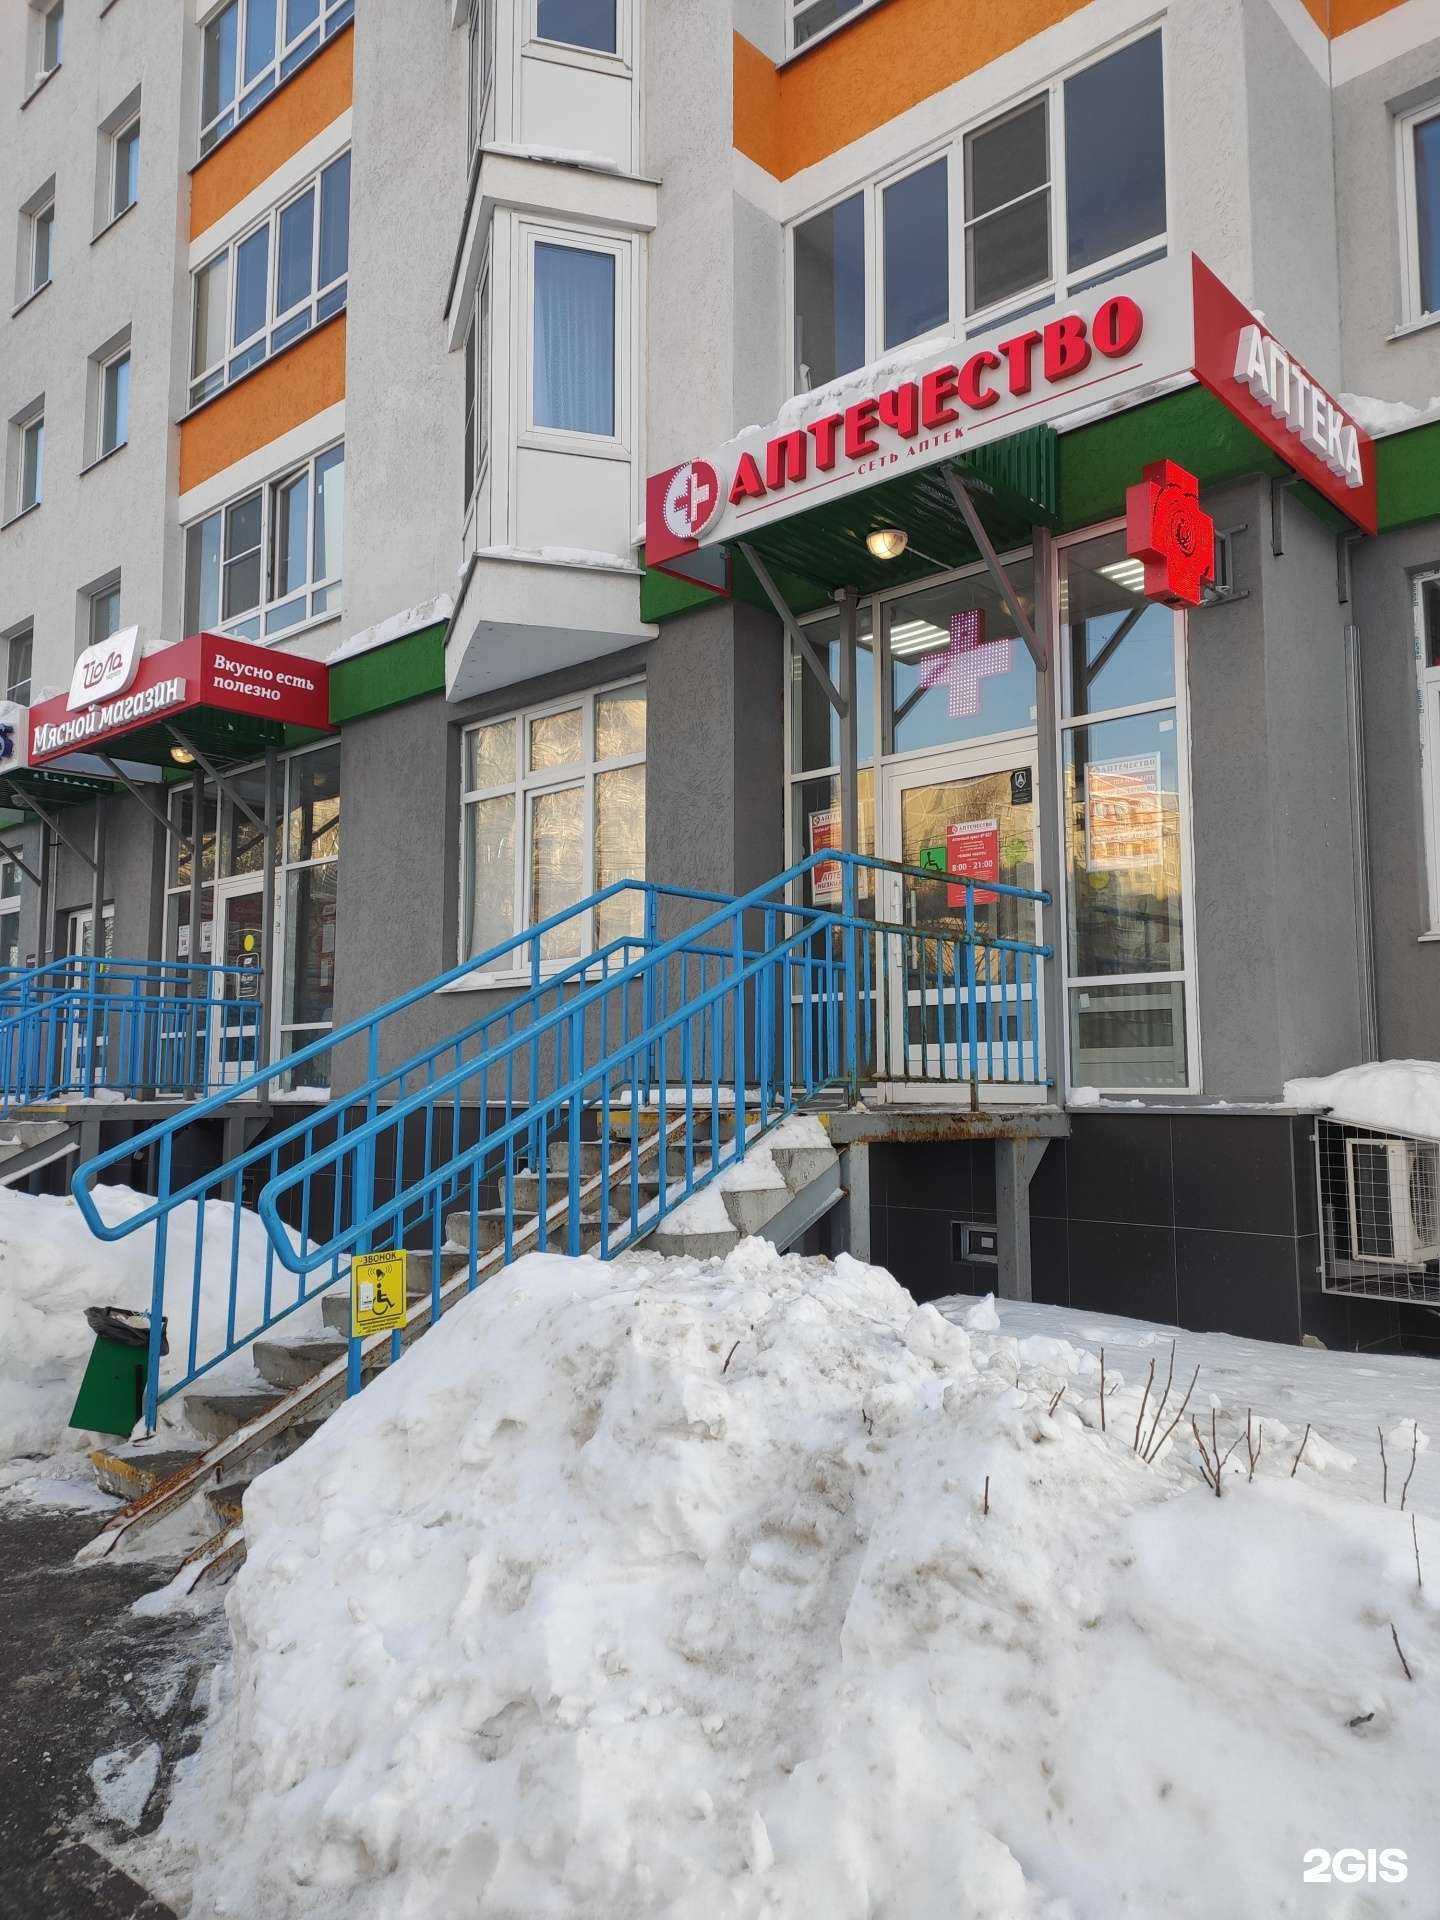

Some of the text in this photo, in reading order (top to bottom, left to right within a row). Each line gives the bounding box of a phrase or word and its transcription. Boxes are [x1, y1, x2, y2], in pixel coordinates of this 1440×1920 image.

[728, 295, 1144, 506] АПТЕЧЕСТВО
[1233, 323, 1364, 489] АПТЕКА
[857, 426, 964, 475] СЕТЬ АПТЕК
[213, 676, 281, 701] полезно
[214, 654, 315, 691] Вкусно есть
[32, 703, 99, 755] Мясной
[99, 676, 187, 729] магазин
[952, 863, 967, 872] 8:00
[973, 860, 993, 869] 21:00
[363, 1252, 397, 1264] ЗВОНОК
